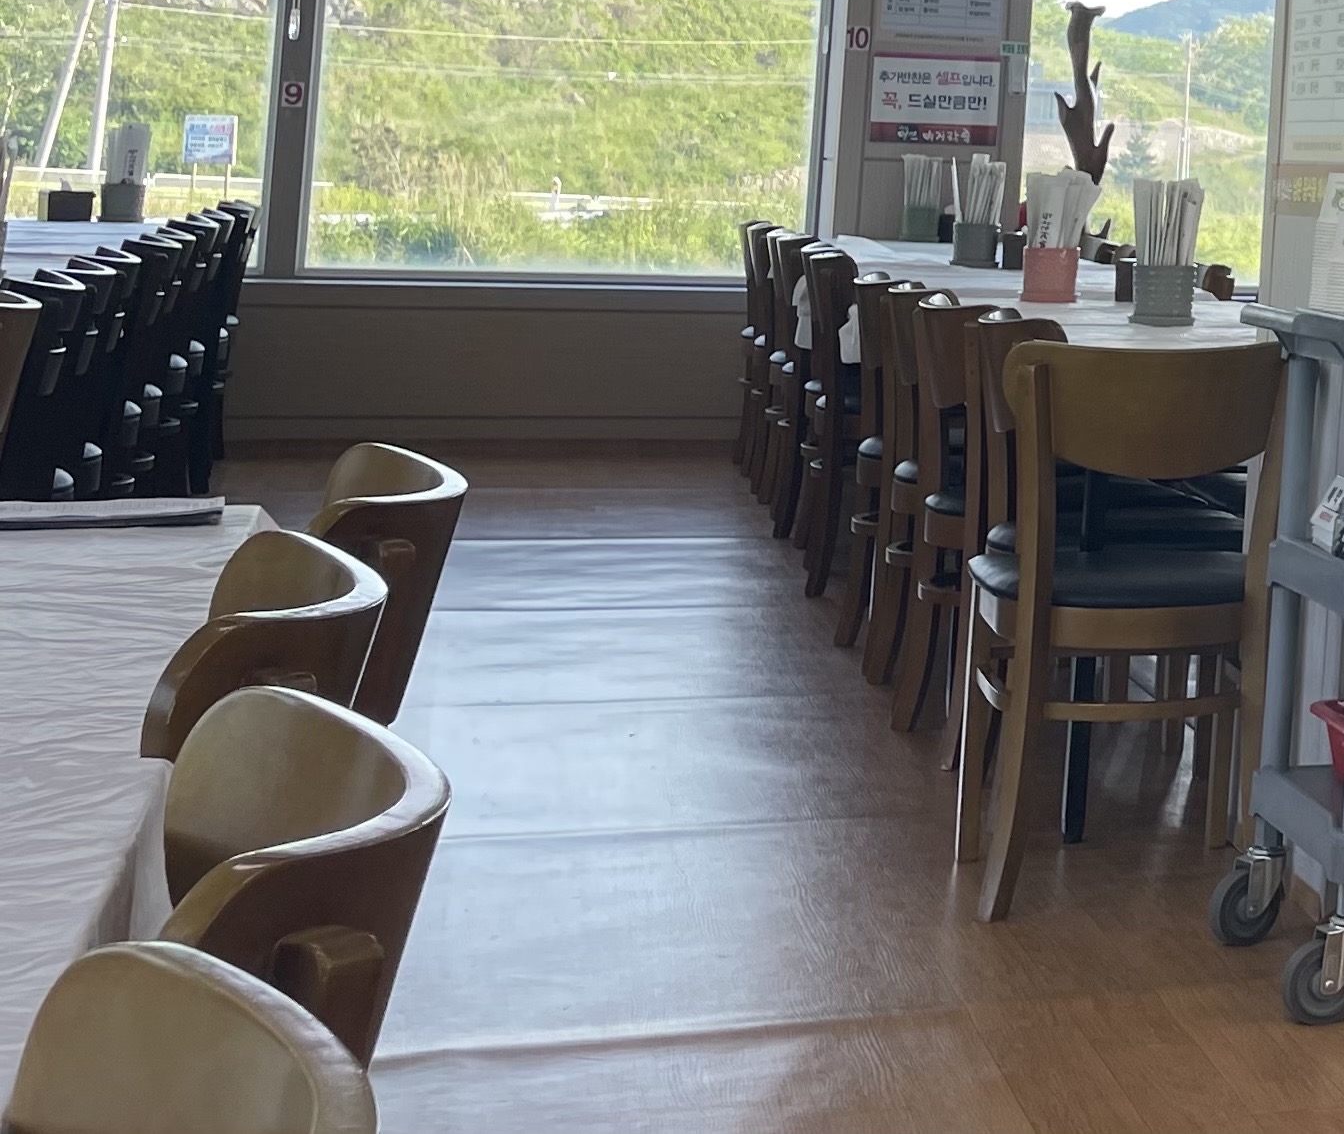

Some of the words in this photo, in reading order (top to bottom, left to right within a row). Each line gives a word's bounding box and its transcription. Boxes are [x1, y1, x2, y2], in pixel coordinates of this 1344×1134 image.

[847, 27, 869, 49] 10
[879, 70, 931, 85] 추가반찬은
[935, 71, 996, 87] 셀프입니다.
[284, 82, 303, 105] 9
[881, 91, 902, 111] 꼭,
[908, 93, 987, 111] 드실만큼만!
